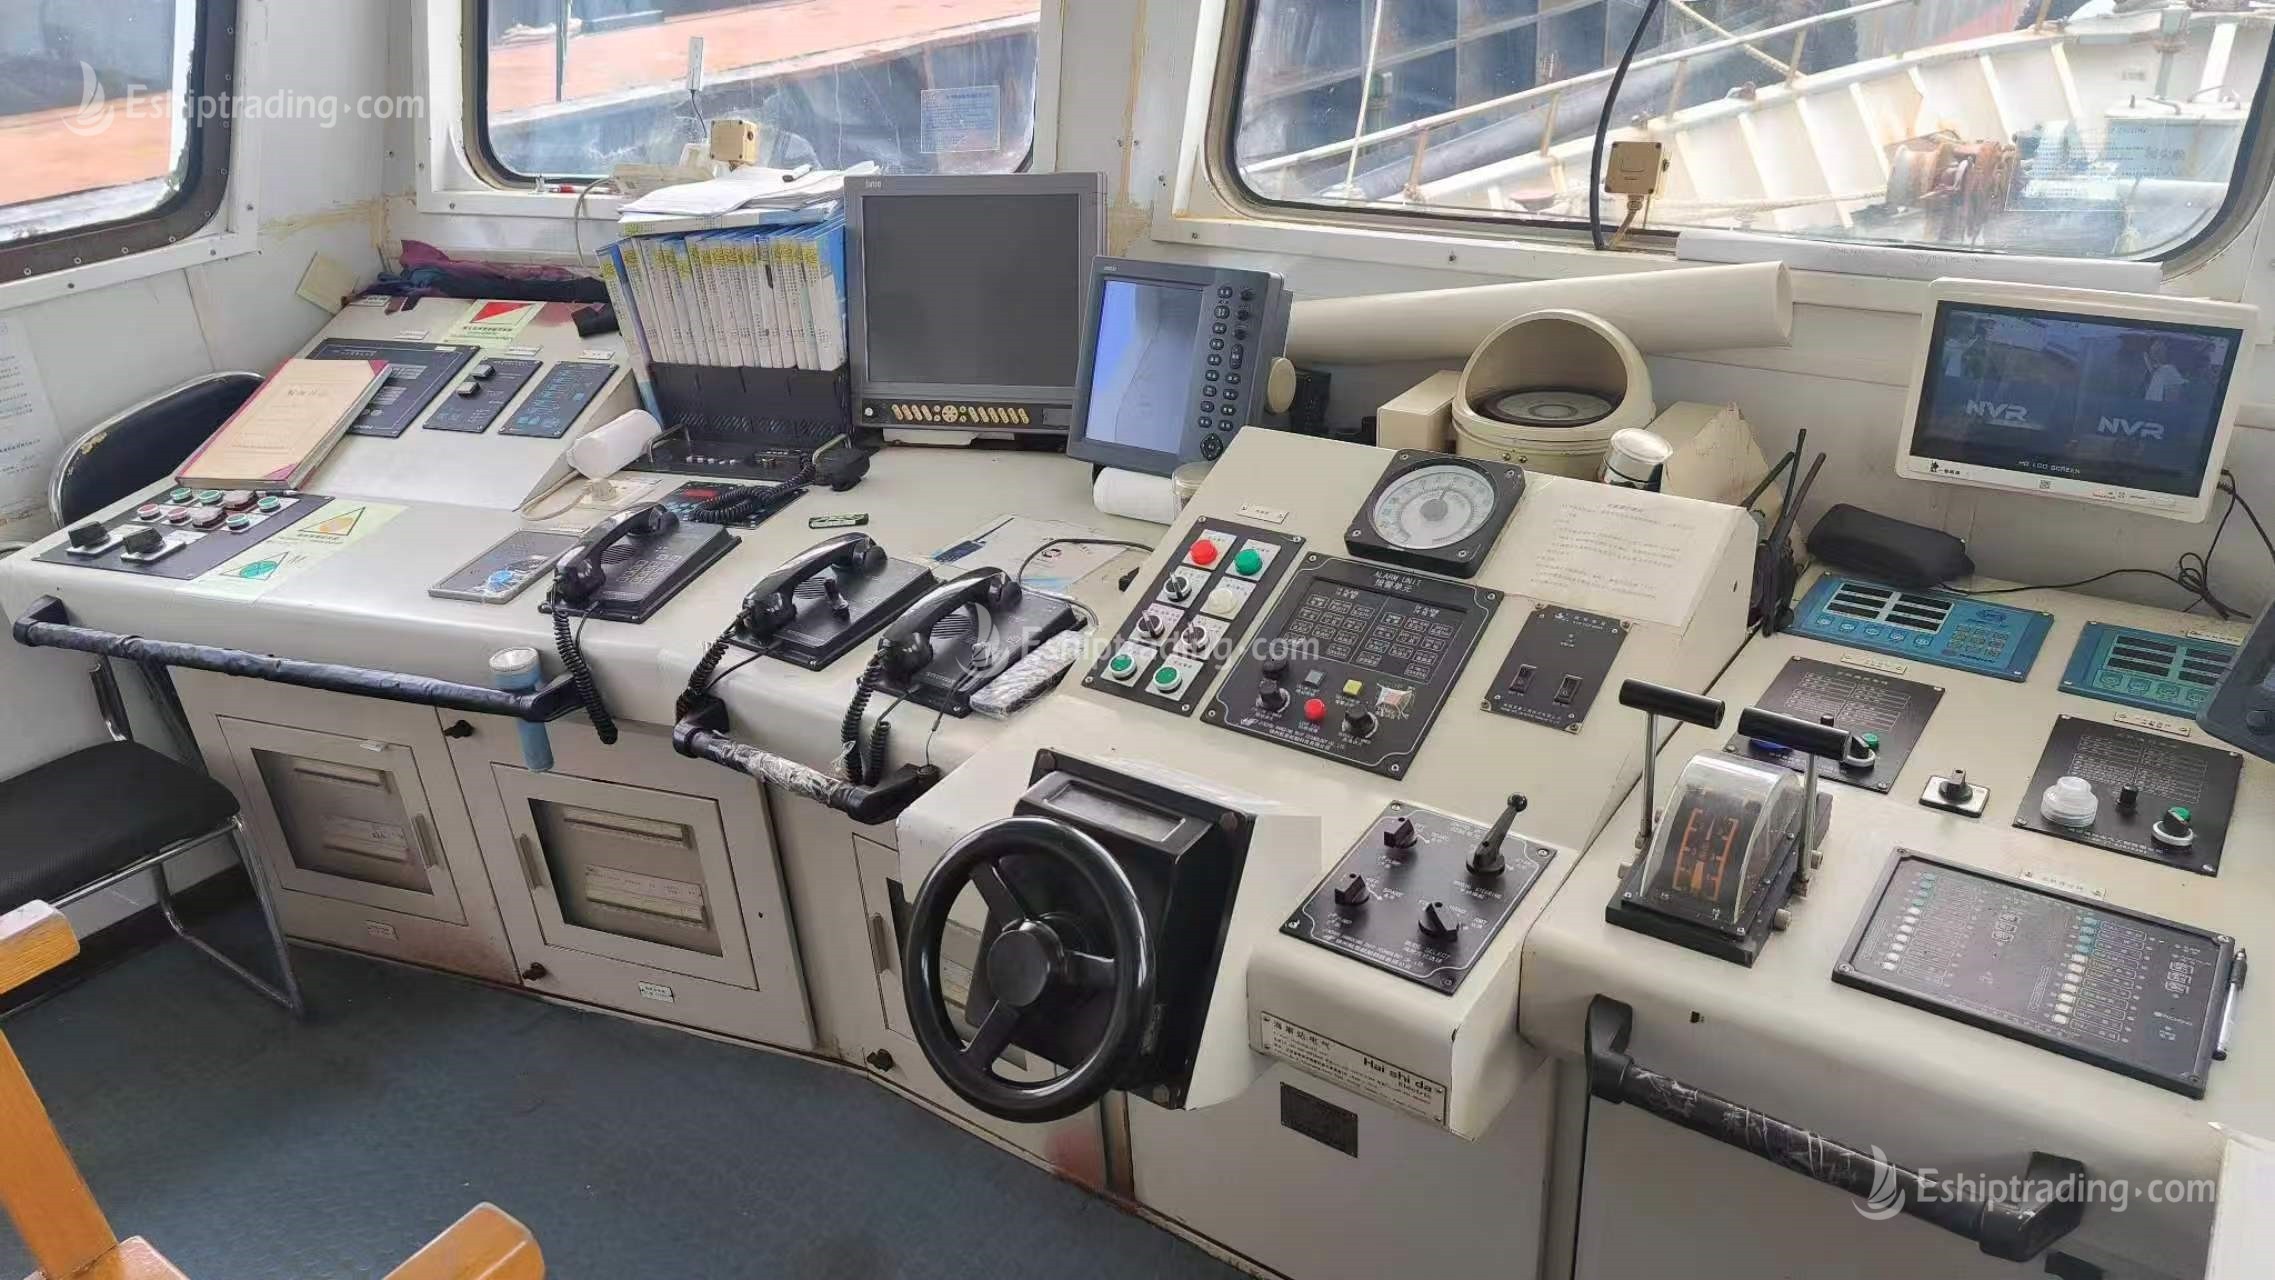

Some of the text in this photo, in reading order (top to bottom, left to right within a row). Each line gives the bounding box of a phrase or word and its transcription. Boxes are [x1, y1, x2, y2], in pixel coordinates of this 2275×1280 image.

[1965, 399, 2029, 422] NVR
[2097, 415, 2165, 440] NVR
[1375, 570, 1422, 587] ALARM UNIT
[1363, 1056, 1385, 1074] Hai
[1389, 1067, 1410, 1084] shi
[1415, 1078, 1433, 1093] da
